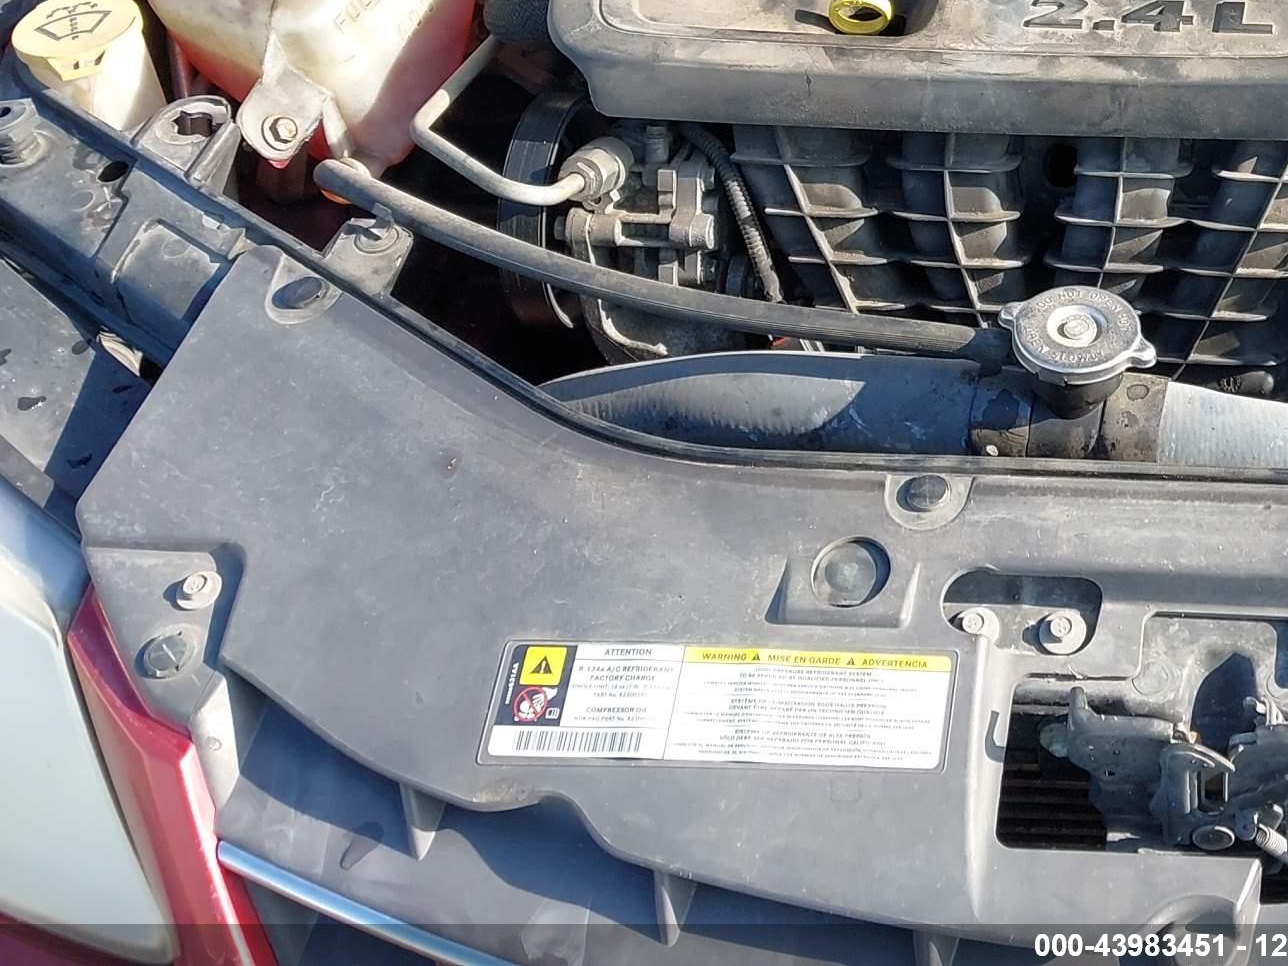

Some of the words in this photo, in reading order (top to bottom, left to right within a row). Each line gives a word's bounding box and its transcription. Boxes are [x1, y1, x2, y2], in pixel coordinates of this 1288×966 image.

[1036, 297, 1054, 309] DO
[1058, 290, 1082, 300] NOT
[1089, 291, 1122, 313] OPEN
[604, 648, 652, 656] ATTENTION
[702, 652, 747, 661] WARNING
[767, 654, 790, 662] MISE
[793, 655, 806, 663] EN
[808, 656, 841, 665] GARDE
[862, 658, 928, 668] ADVERTENCIA
[606, 665, 621, 673] A/C
